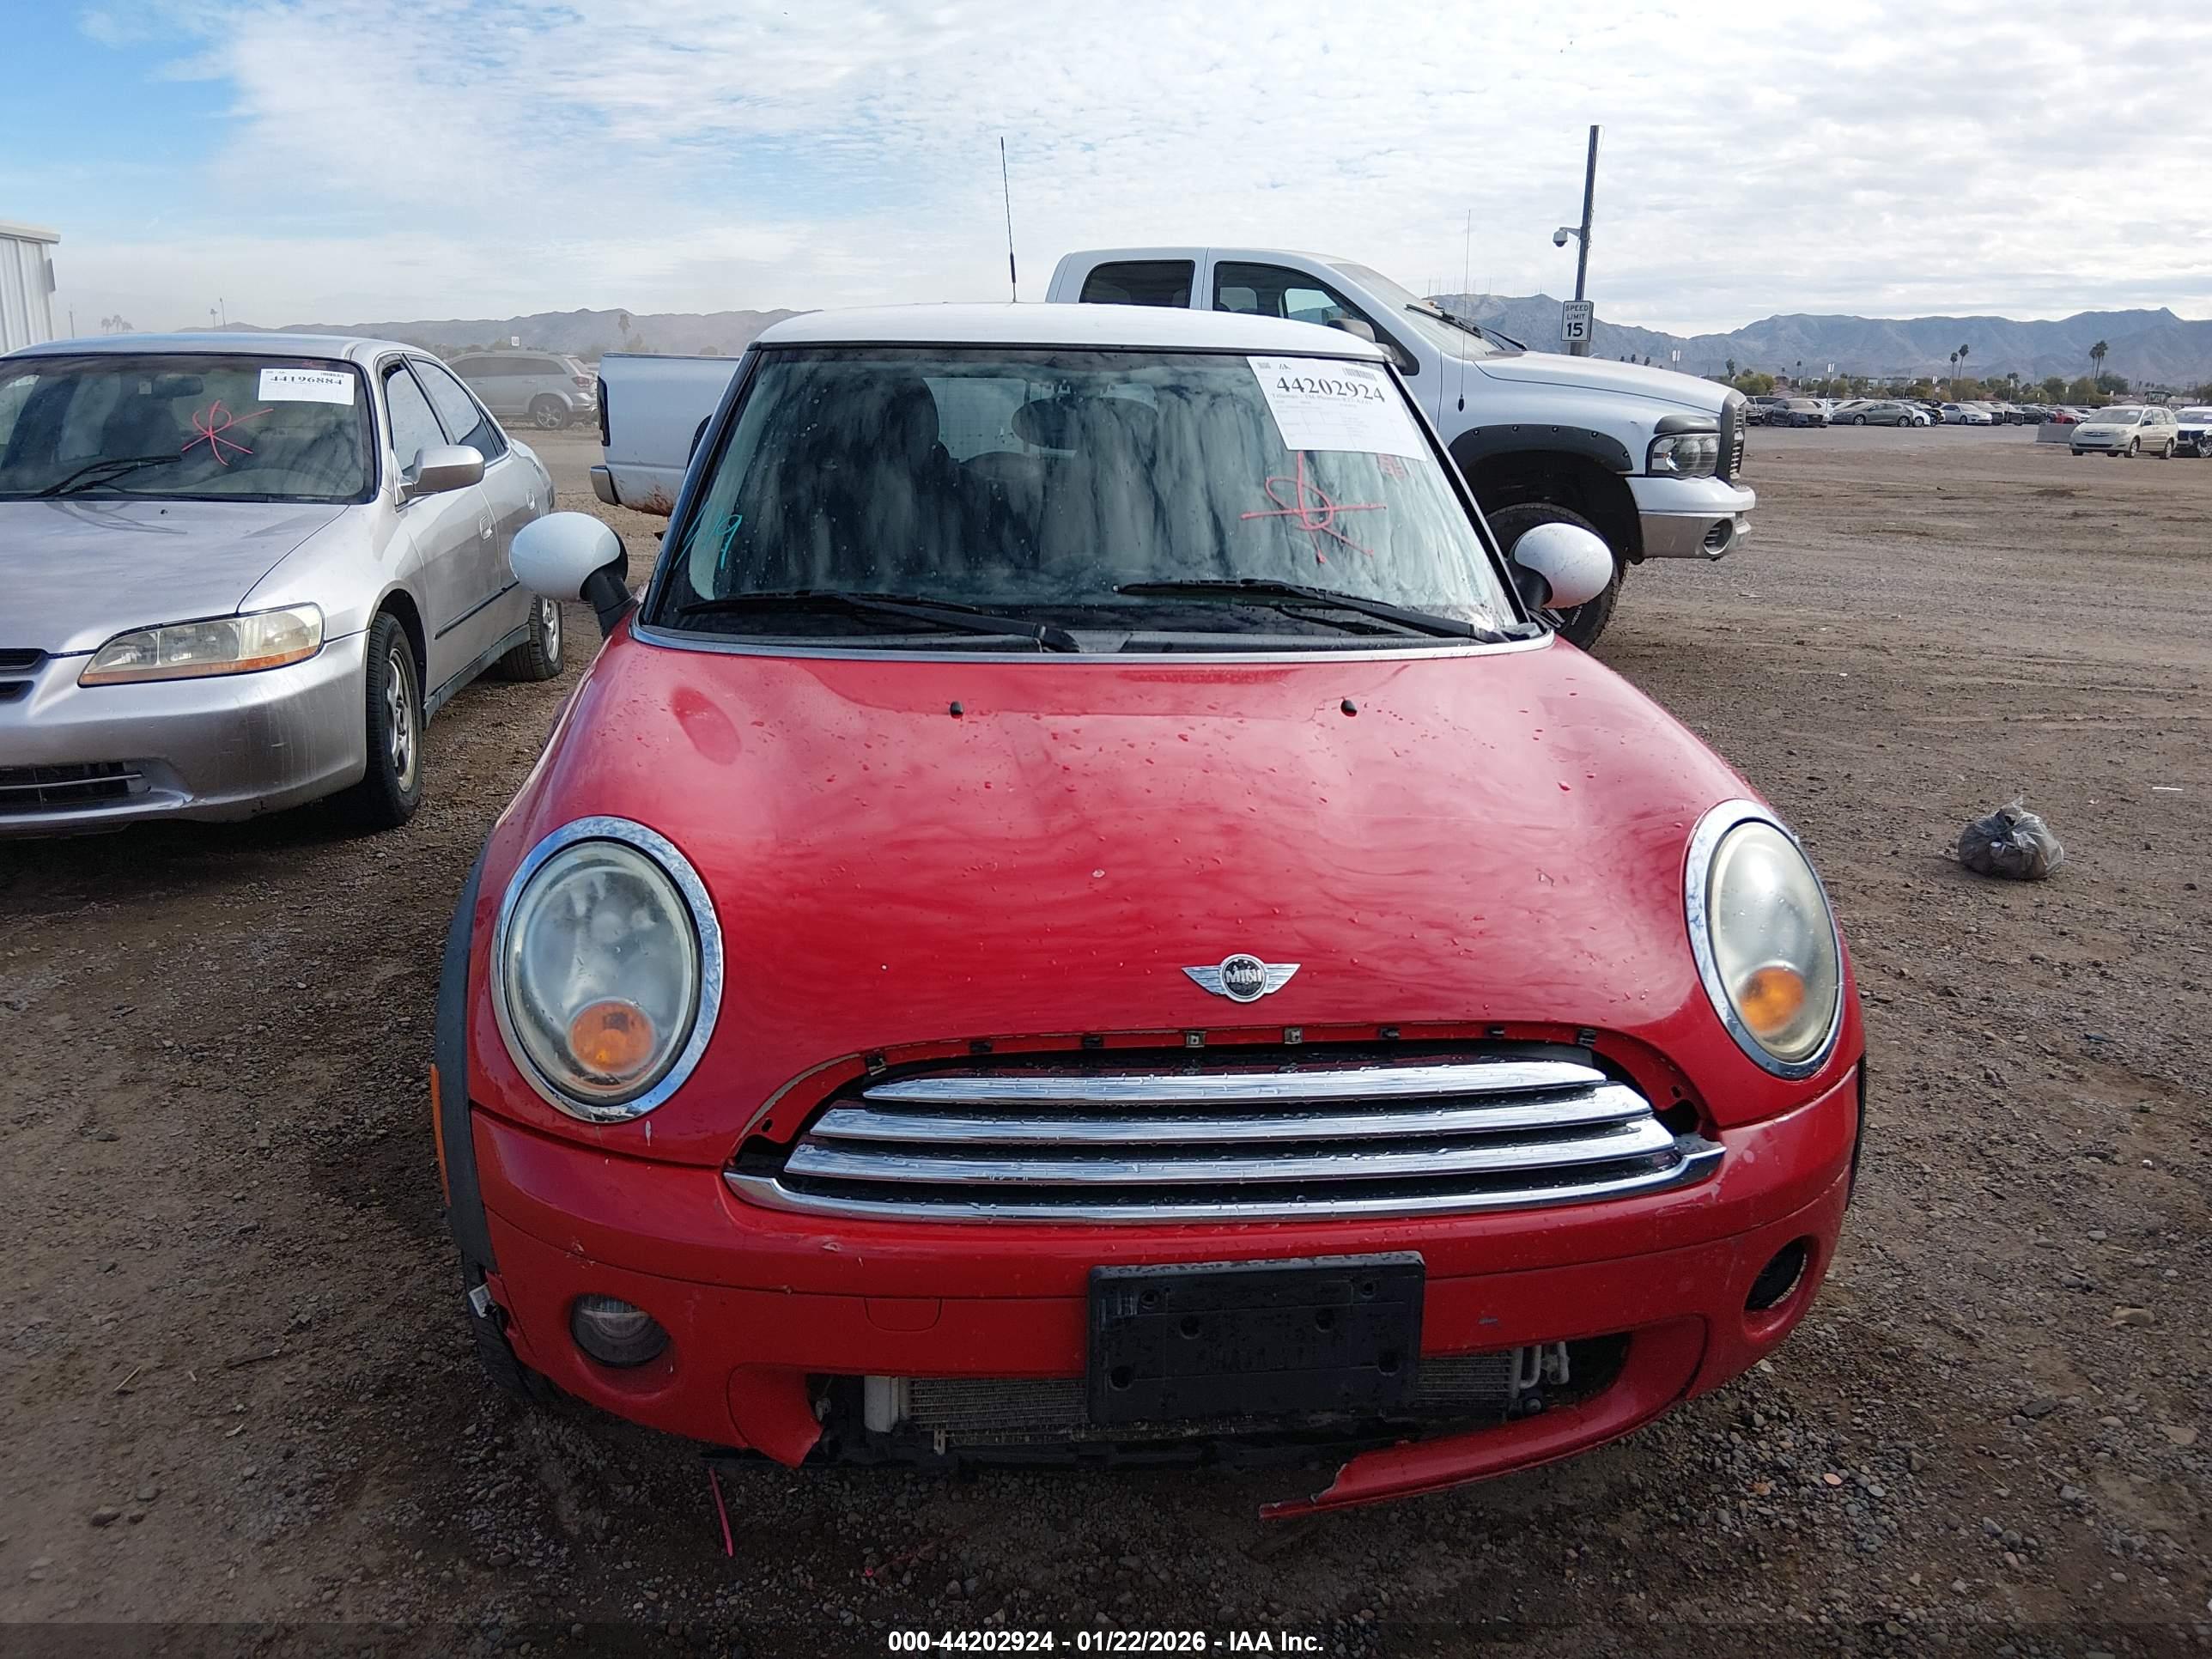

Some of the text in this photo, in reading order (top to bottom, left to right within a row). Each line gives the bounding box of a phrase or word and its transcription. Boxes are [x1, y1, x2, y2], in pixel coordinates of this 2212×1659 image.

[1566, 322, 1583, 337] 15
[270, 375, 343, 385] 44196884
[1276, 376, 1385, 403] 44202924
[1226, 968, 1262, 984] MINI
